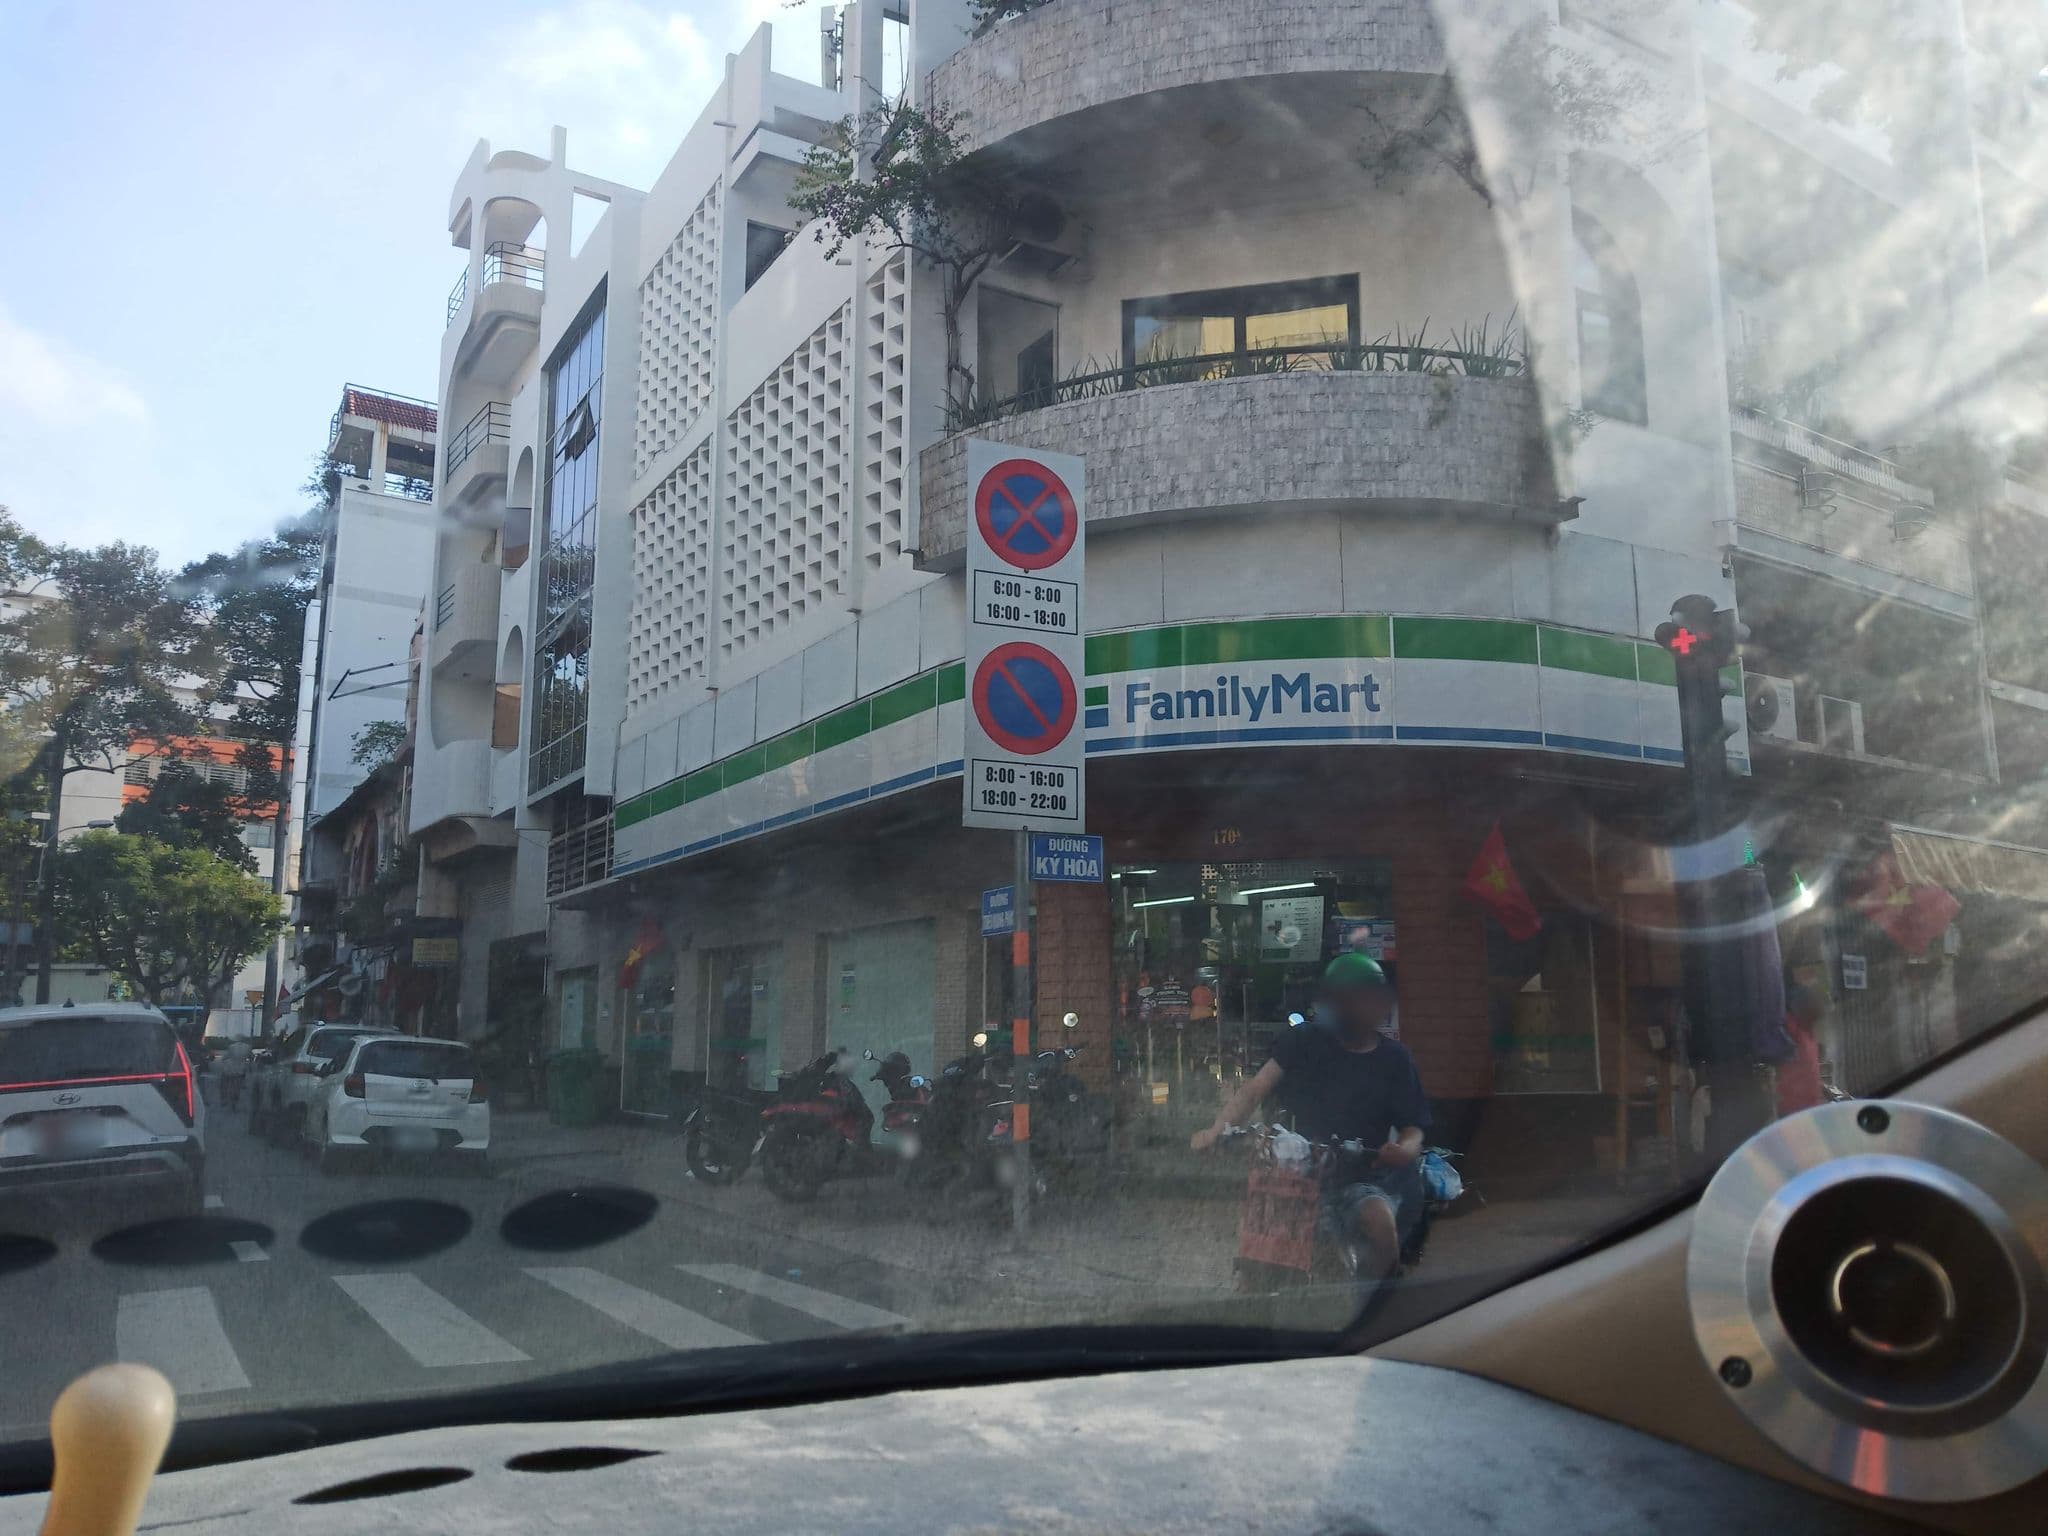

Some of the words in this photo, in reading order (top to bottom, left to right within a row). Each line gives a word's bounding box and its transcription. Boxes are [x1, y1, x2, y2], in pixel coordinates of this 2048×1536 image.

[994, 580, 1020, 598] 6:00
[1035, 586, 1061, 603] 8:00
[987, 603, 1020, 621] 16:00
[1034, 609, 1066, 627] 18:00
[1126, 672, 1380, 722] FamilyMart
[986, 766, 1015, 784] 8:00
[1030, 770, 1064, 788] 16:00
[982, 789, 1017, 807] 18:00
[1031, 793, 1066, 811] 22:00
[1048, 836, 1089, 853] ĐƯỜNG
[1036, 854, 1060, 875] KÝ
[1064, 855, 1099, 877] HÒA
